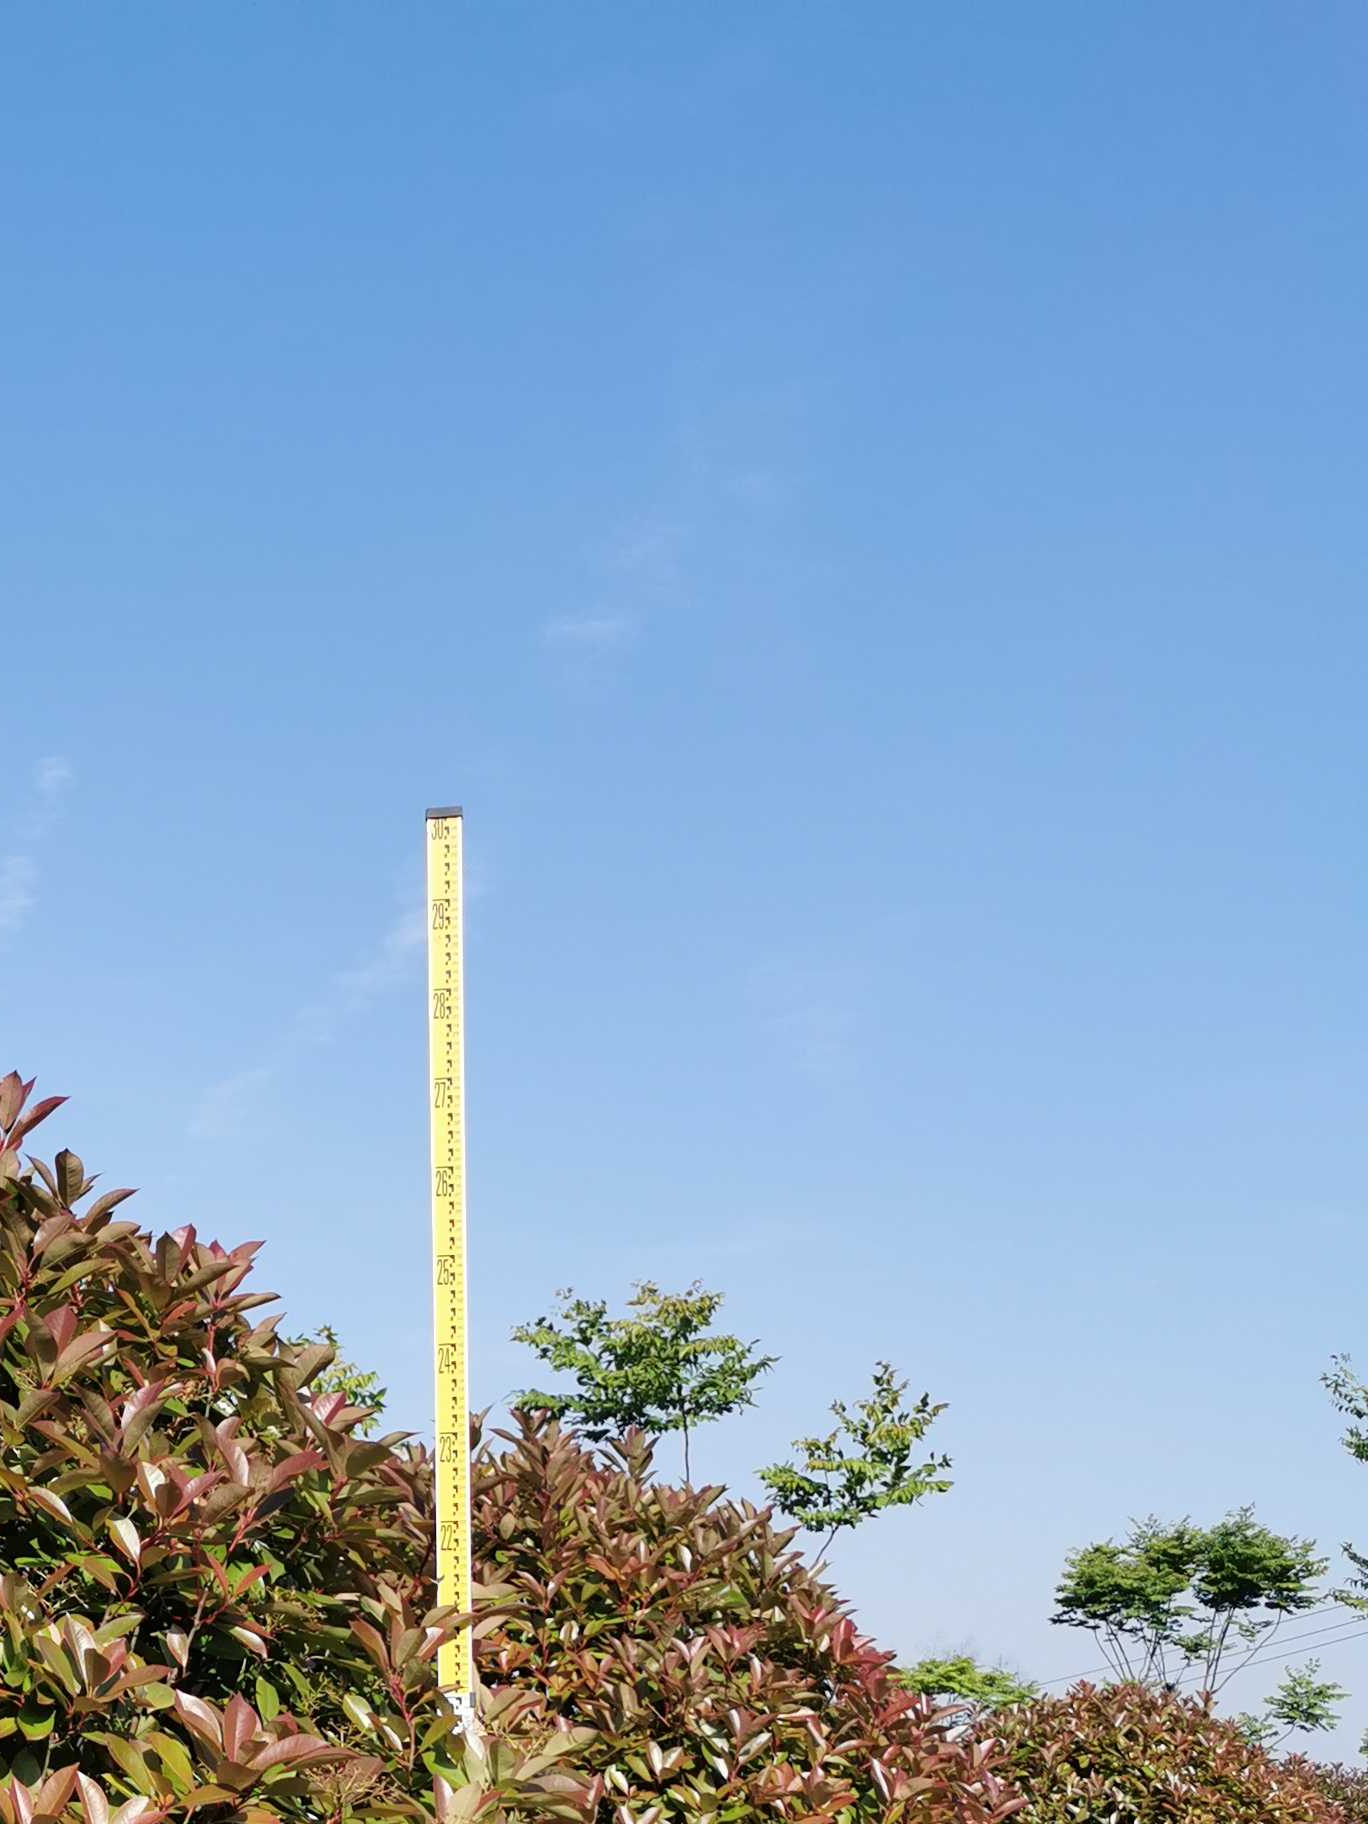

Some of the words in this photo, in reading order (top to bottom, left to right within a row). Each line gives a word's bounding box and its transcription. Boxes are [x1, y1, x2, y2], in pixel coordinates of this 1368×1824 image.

[432, 903, 444, 930] 29
[433, 992, 445, 1019] 28
[434, 1081, 446, 1108] 27
[435, 1170, 448, 1197] 26
[437, 1259, 449, 1285] 25
[438, 1347, 451, 1374] 24
[439, 1436, 451, 1462] 23
[440, 1524, 452, 1551] 22
